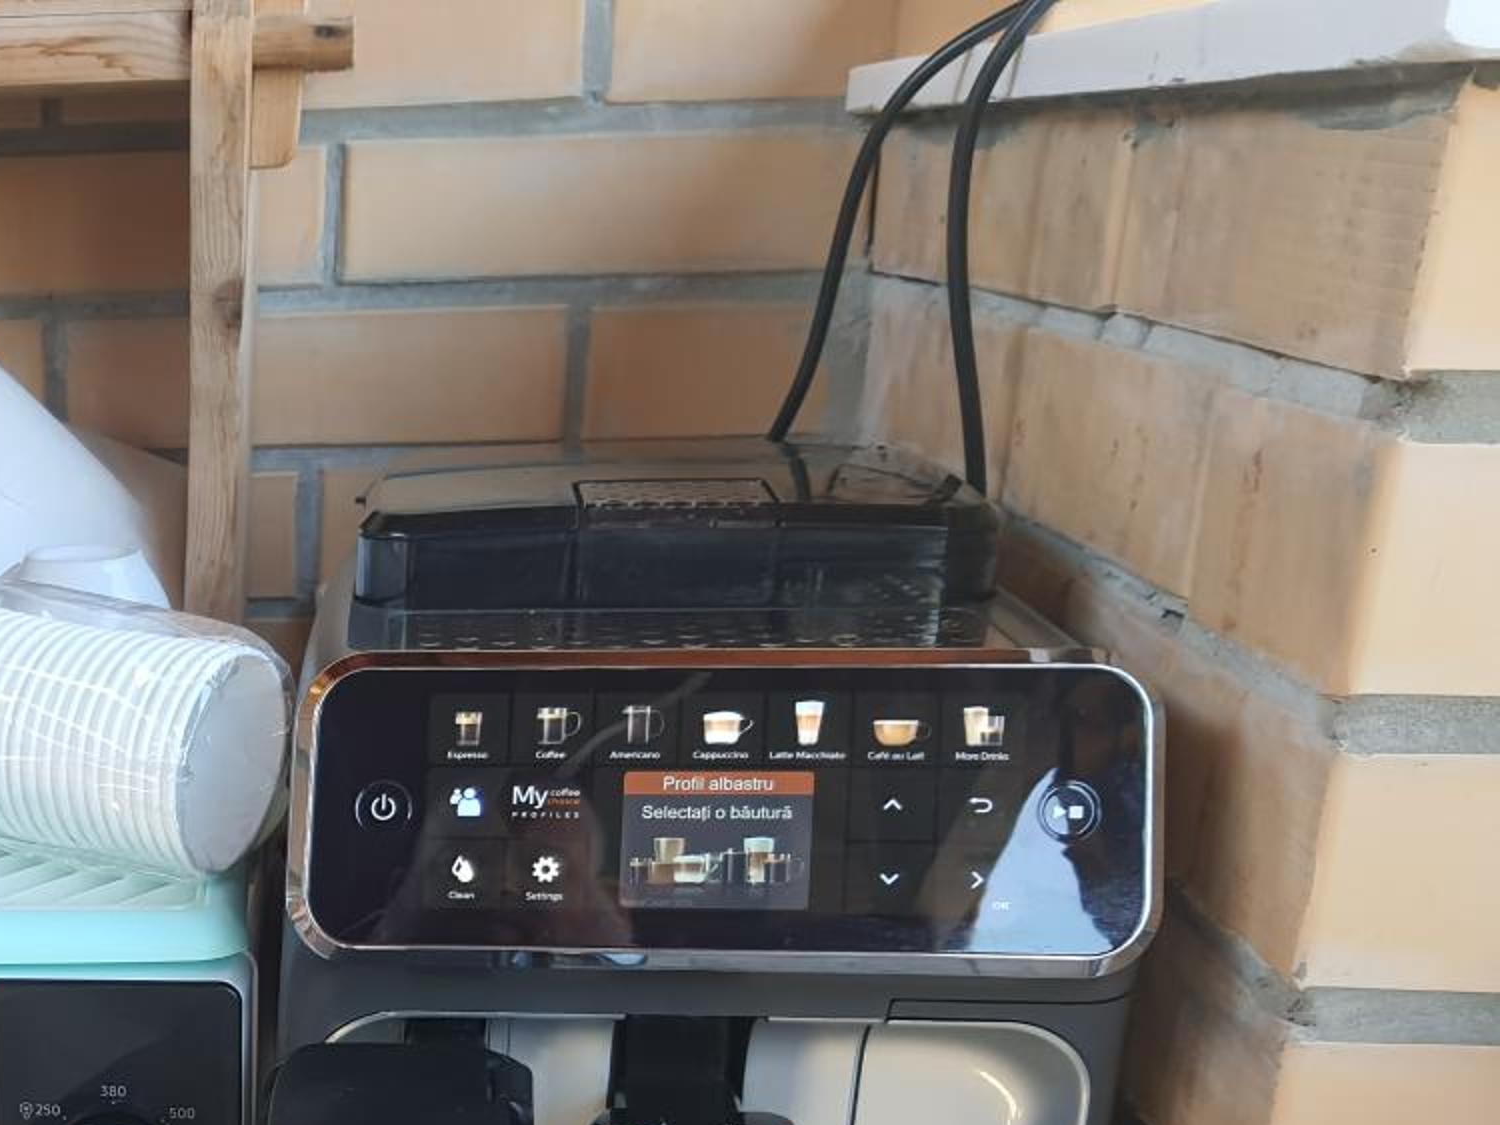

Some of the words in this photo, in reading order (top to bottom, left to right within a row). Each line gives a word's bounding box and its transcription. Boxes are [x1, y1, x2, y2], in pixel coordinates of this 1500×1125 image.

[447, 751, 489, 761] Espresso
[535, 750, 566, 760] Coffee
[609, 750, 661, 760] Americano
[692, 750, 750, 761] Cappuccino
[769, 750, 794, 760] Latte
[795, 750, 847, 761] Macchiato
[906, 751, 925, 761] Lait
[955, 751, 979, 761] More
[980, 751, 1010, 762] Drinks
[708, 776, 774, 792] albastru
[512, 785, 549, 809] My
[549, 788, 581, 798] coffee
[511, 811, 581, 819] PROFILES
[715, 809, 726, 820] o
[730, 805, 794, 820] băutură
[448, 890, 476, 900] Clean
[525, 890, 564, 903] Settings
[99, 1085, 128, 1098] 380
[35, 1105, 62, 1117] 250
[169, 1107, 196, 1120] 500
